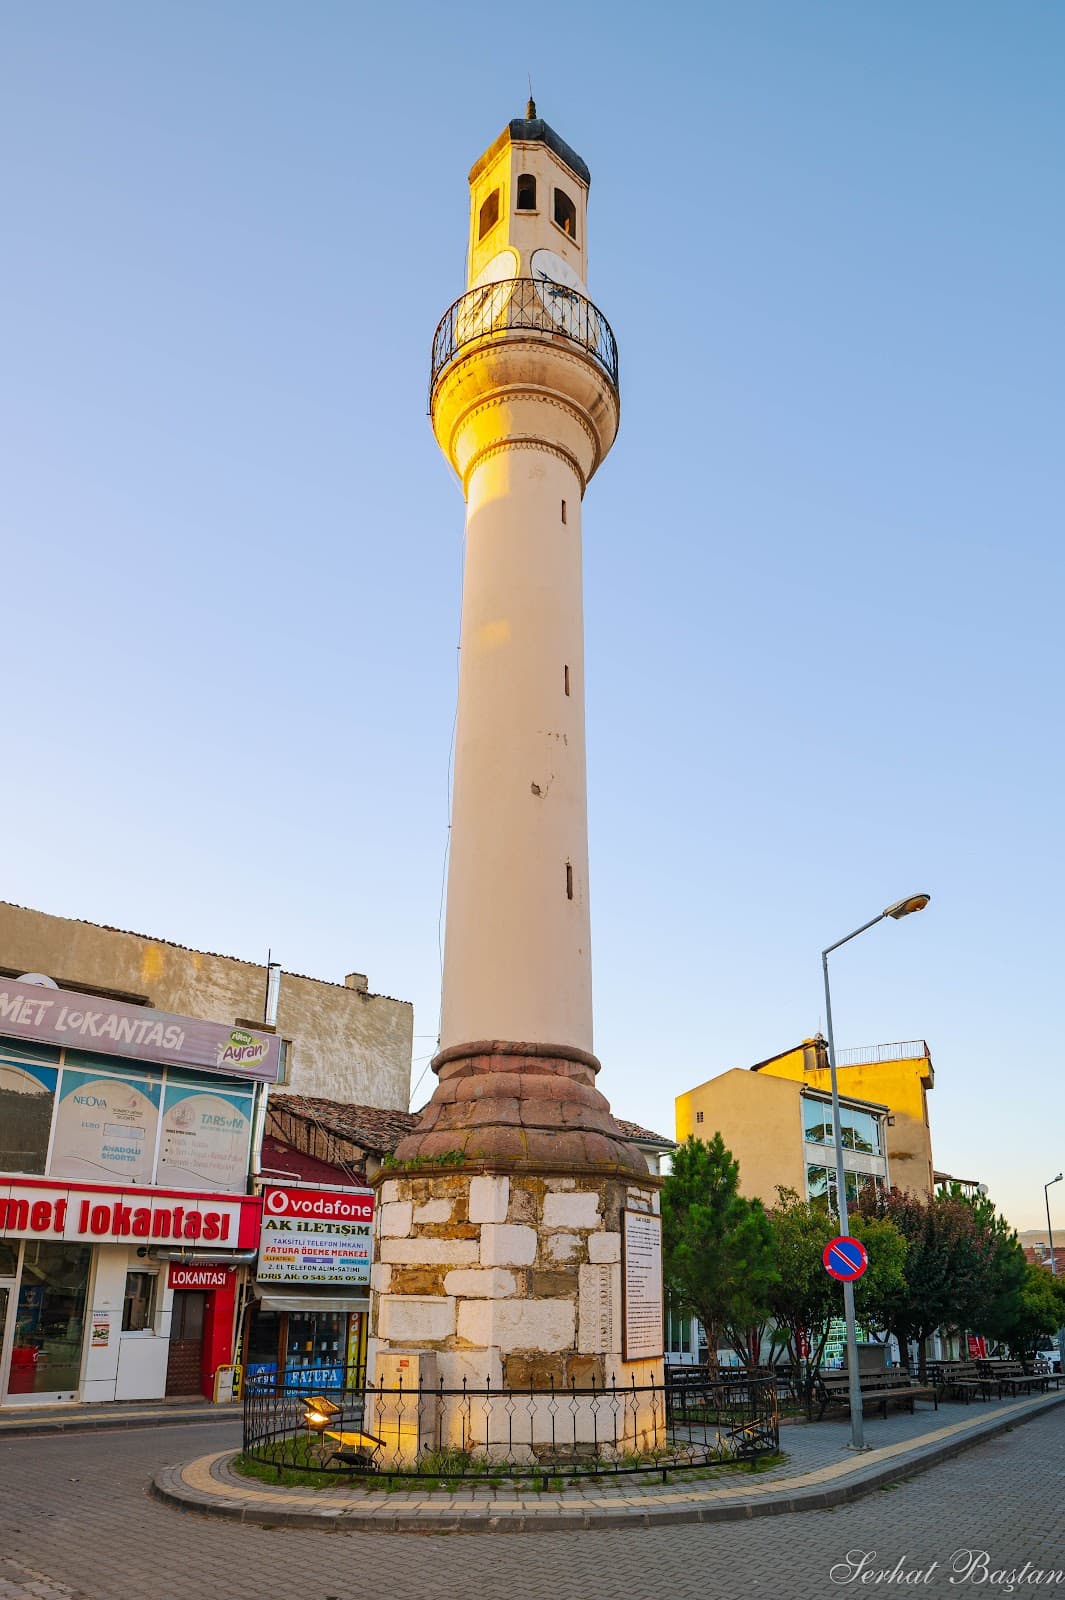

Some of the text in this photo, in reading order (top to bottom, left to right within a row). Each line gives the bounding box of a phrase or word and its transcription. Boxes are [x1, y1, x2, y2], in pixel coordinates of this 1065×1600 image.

[223, 1045, 263, 1061] Ayran
[291, 1199, 372, 1217] vodafone
[78, 1200, 231, 1241] lokantası
[265, 1219, 292, 1231] AK
[307, 1239, 338, 1247] TELEFON
[265, 1246, 300, 1255] FATURA
[301, 1246, 330, 1256] ÖDEME
[172, 1271, 226, 1285] LOKANTASI
